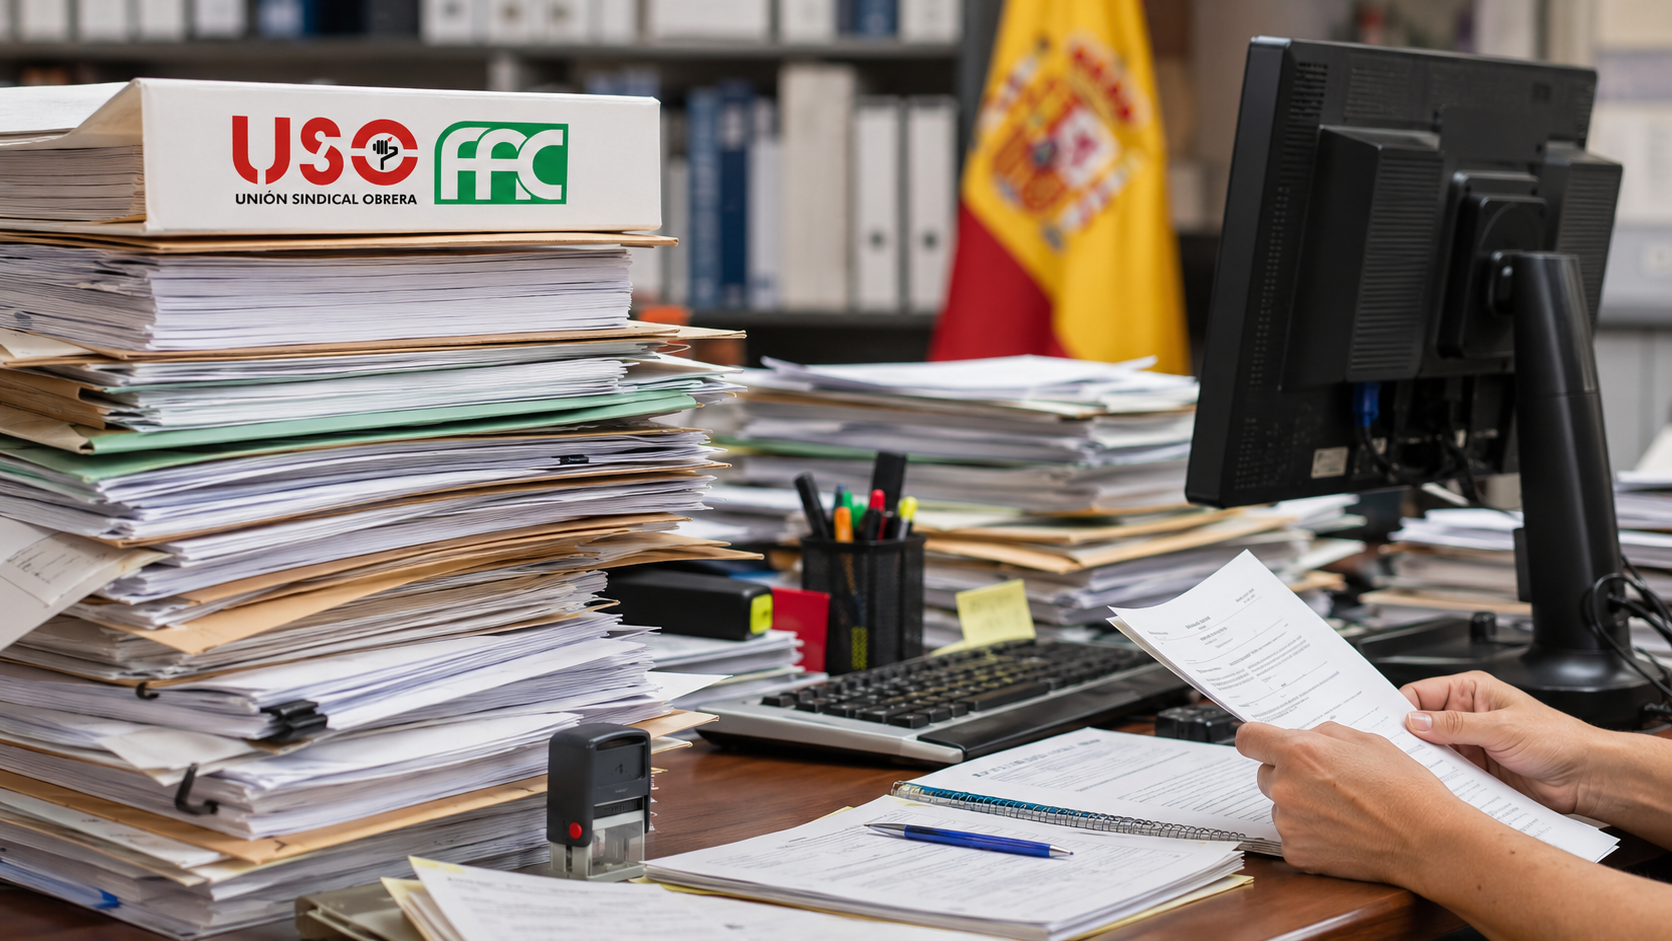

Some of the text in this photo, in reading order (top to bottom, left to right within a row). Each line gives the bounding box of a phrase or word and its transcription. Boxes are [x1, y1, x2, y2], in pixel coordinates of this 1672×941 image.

[232, 115, 418, 186] USO
[235, 189, 418, 205] UNIÓN SINDICAL OBRERA
